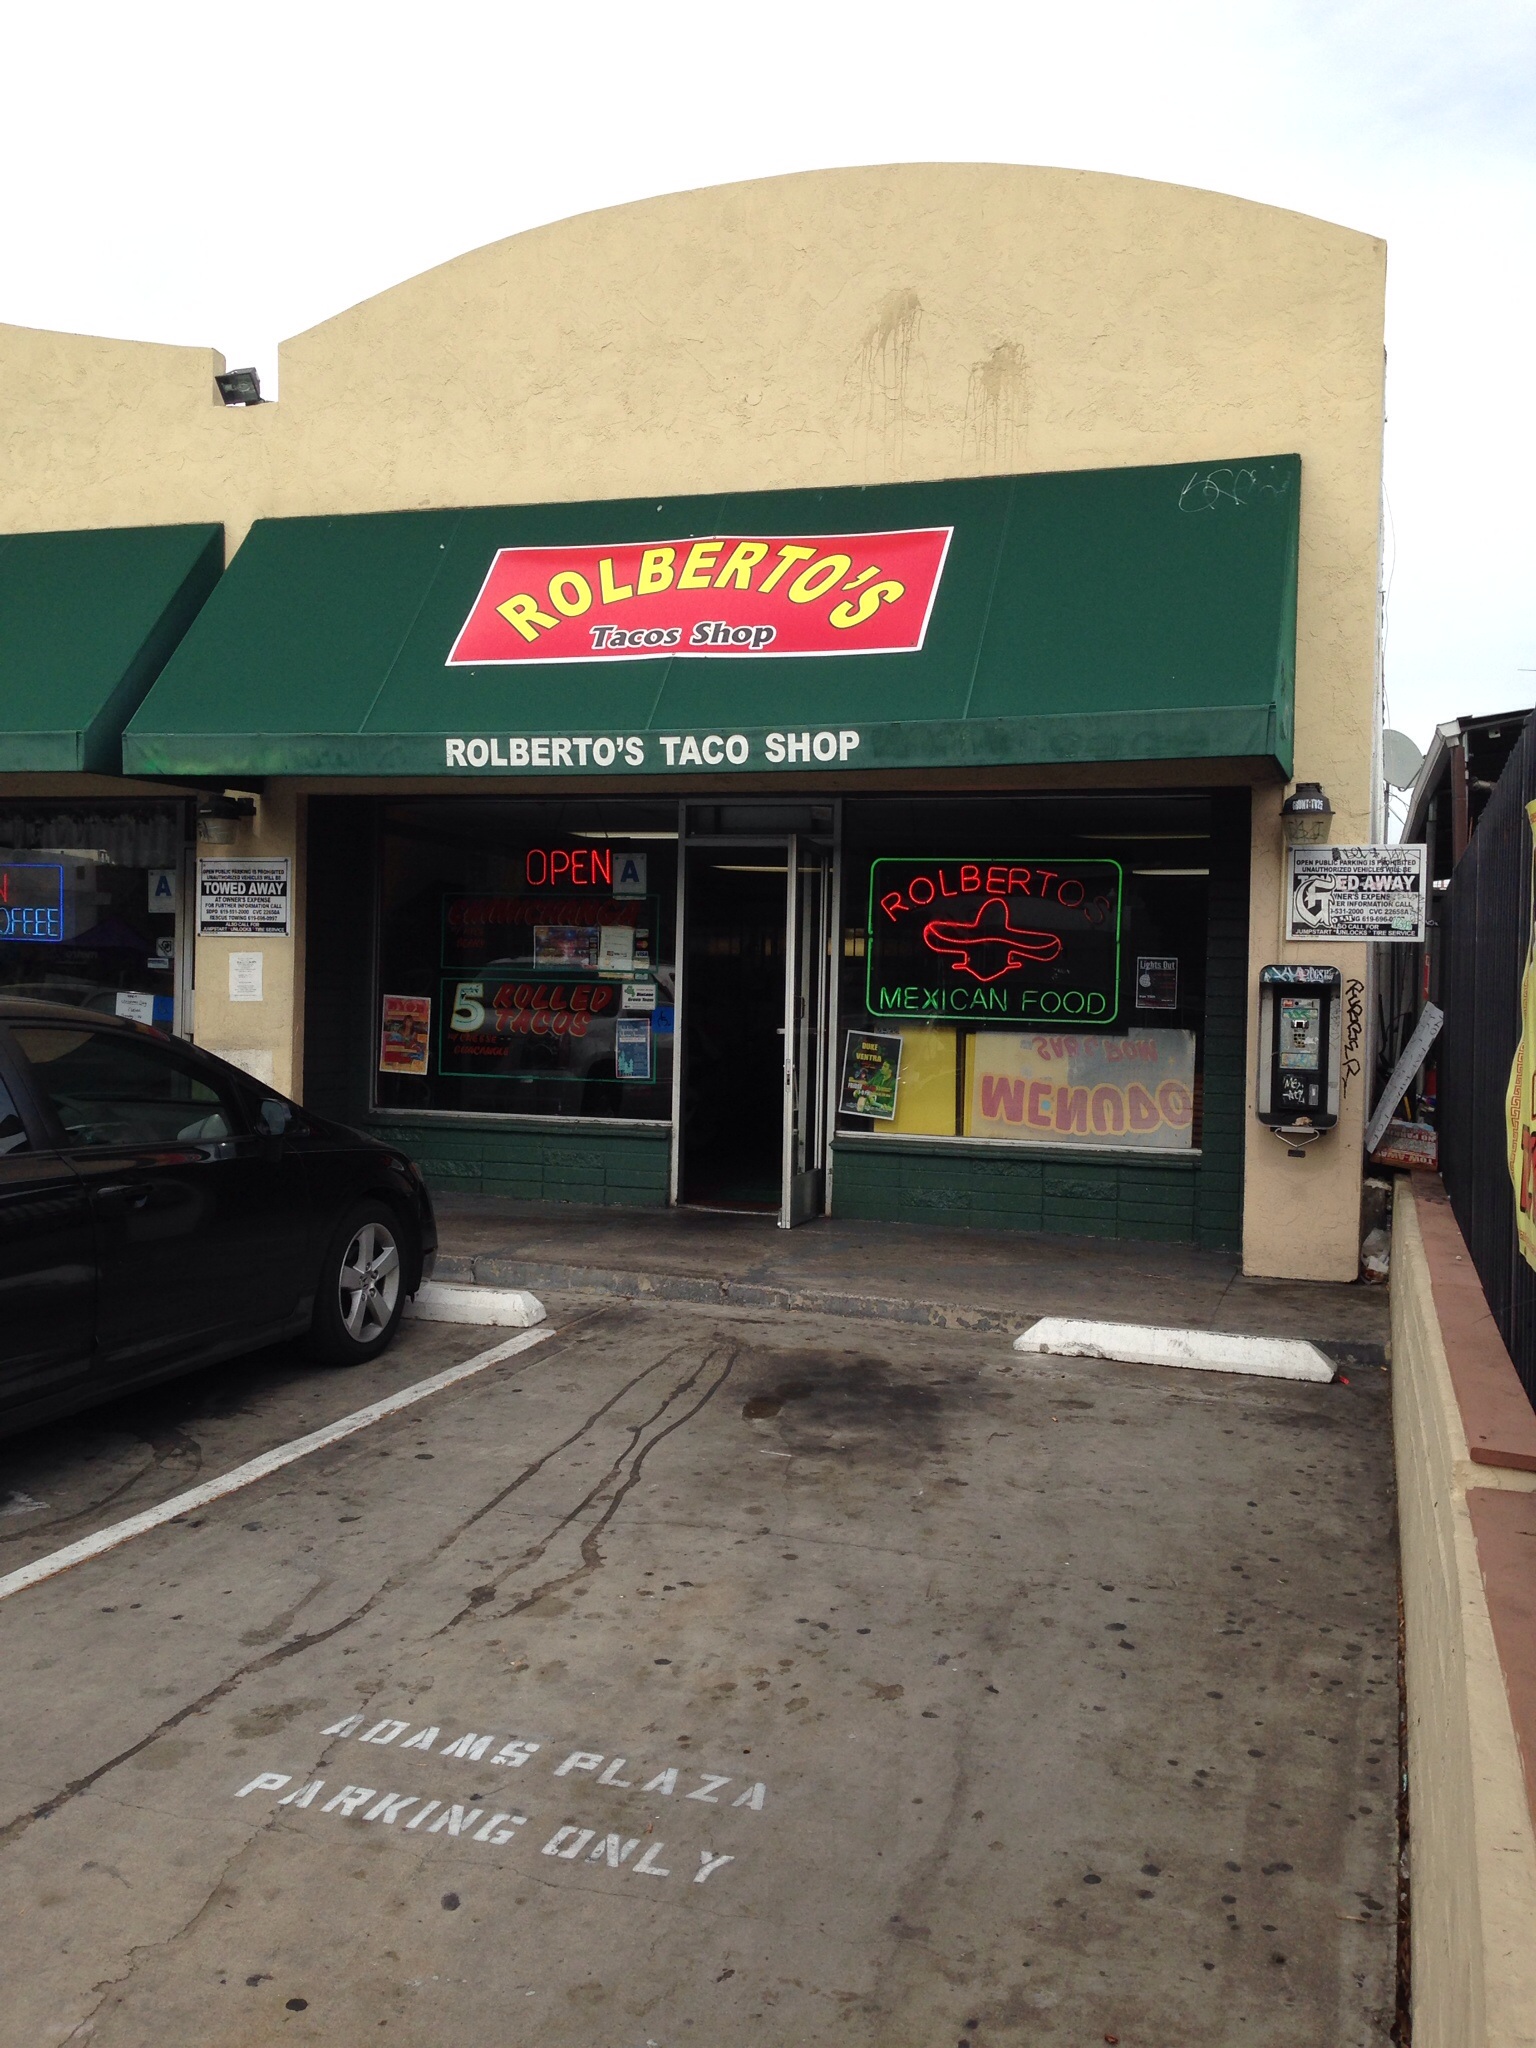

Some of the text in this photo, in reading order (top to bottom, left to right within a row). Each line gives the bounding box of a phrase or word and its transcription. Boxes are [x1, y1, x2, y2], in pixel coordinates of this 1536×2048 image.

[496, 541, 906, 643] ROLBERTO'S
[590, 621, 776, 650] Tacos Shop
[445, 731, 860, 767] ROLBERTO'S TACO SHOP
[526, 849, 612, 885] OPEN
[620, 860, 639, 883] A
[155, 876, 172, 897] A
[204, 881, 284, 895] TOWED AWAY
[1162, 960, 1175, 970] Out
[450, 982, 613, 1033] 5 ROLLED
[879, 987, 1106, 1015] MEXICAN FOOD
[494, 1009, 592, 1038] TACOS
[319, 1713, 768, 1811] ADAMS PLAZA
[234, 1772, 736, 1884] PARKING ONLY
